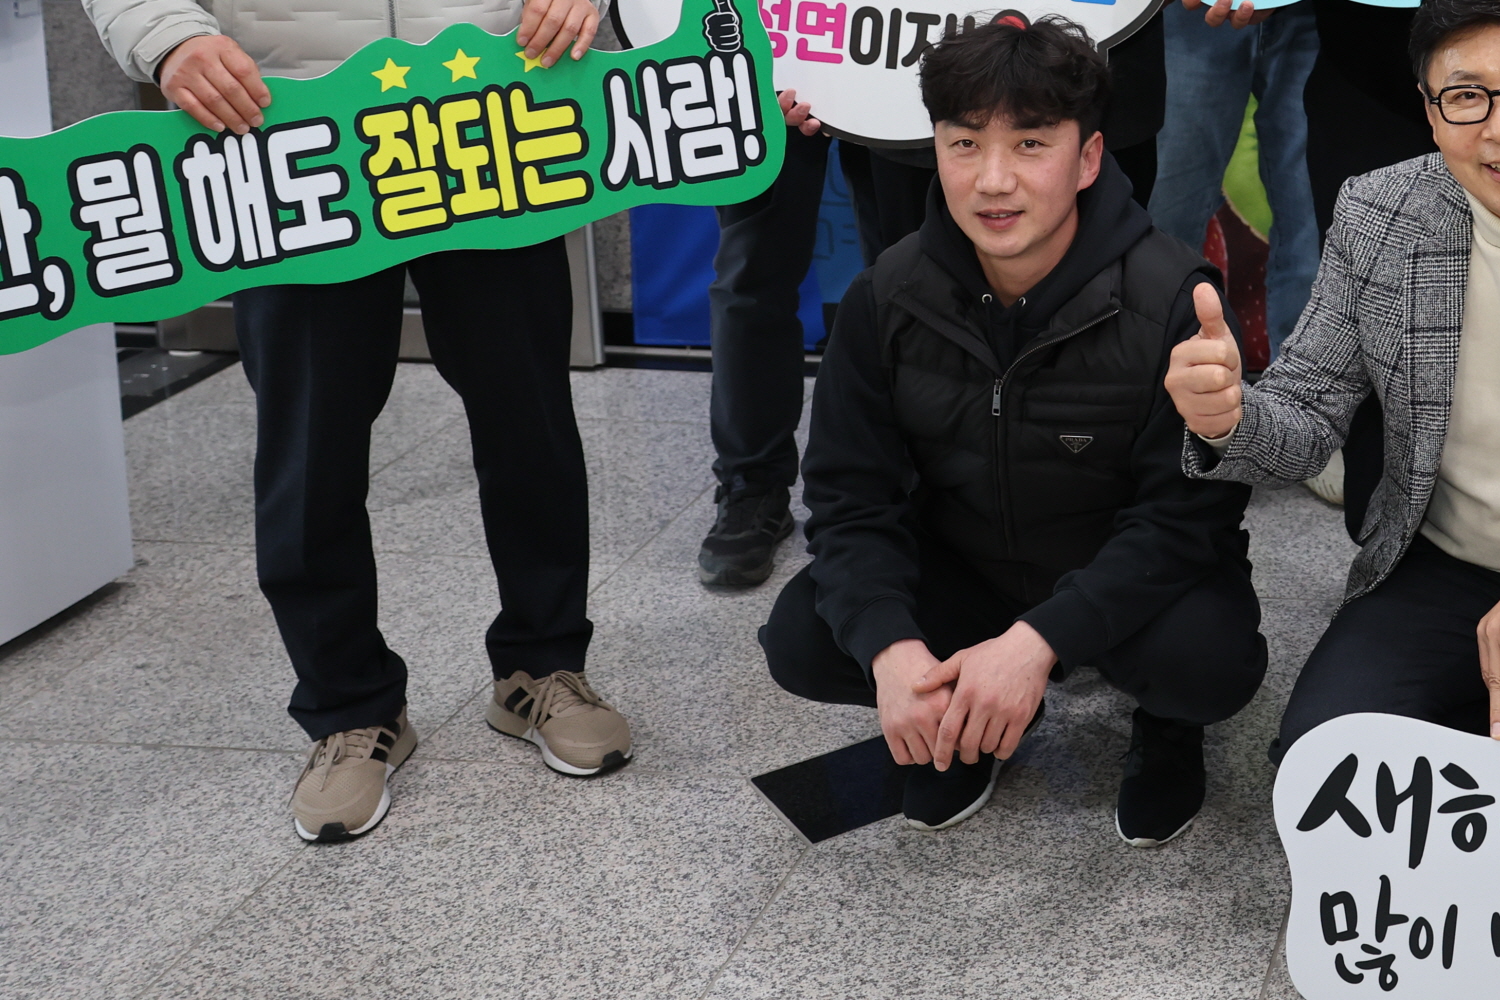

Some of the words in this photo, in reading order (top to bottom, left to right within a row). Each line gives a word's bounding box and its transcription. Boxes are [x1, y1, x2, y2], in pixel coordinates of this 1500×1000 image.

[67, 143, 182, 297] 뭘
[179, 115, 361, 269] 해도
[355, 82, 593, 240] 잘되는
[602, 50, 766, 191] 사람!
[1319, 874, 1459, 992] 많이
